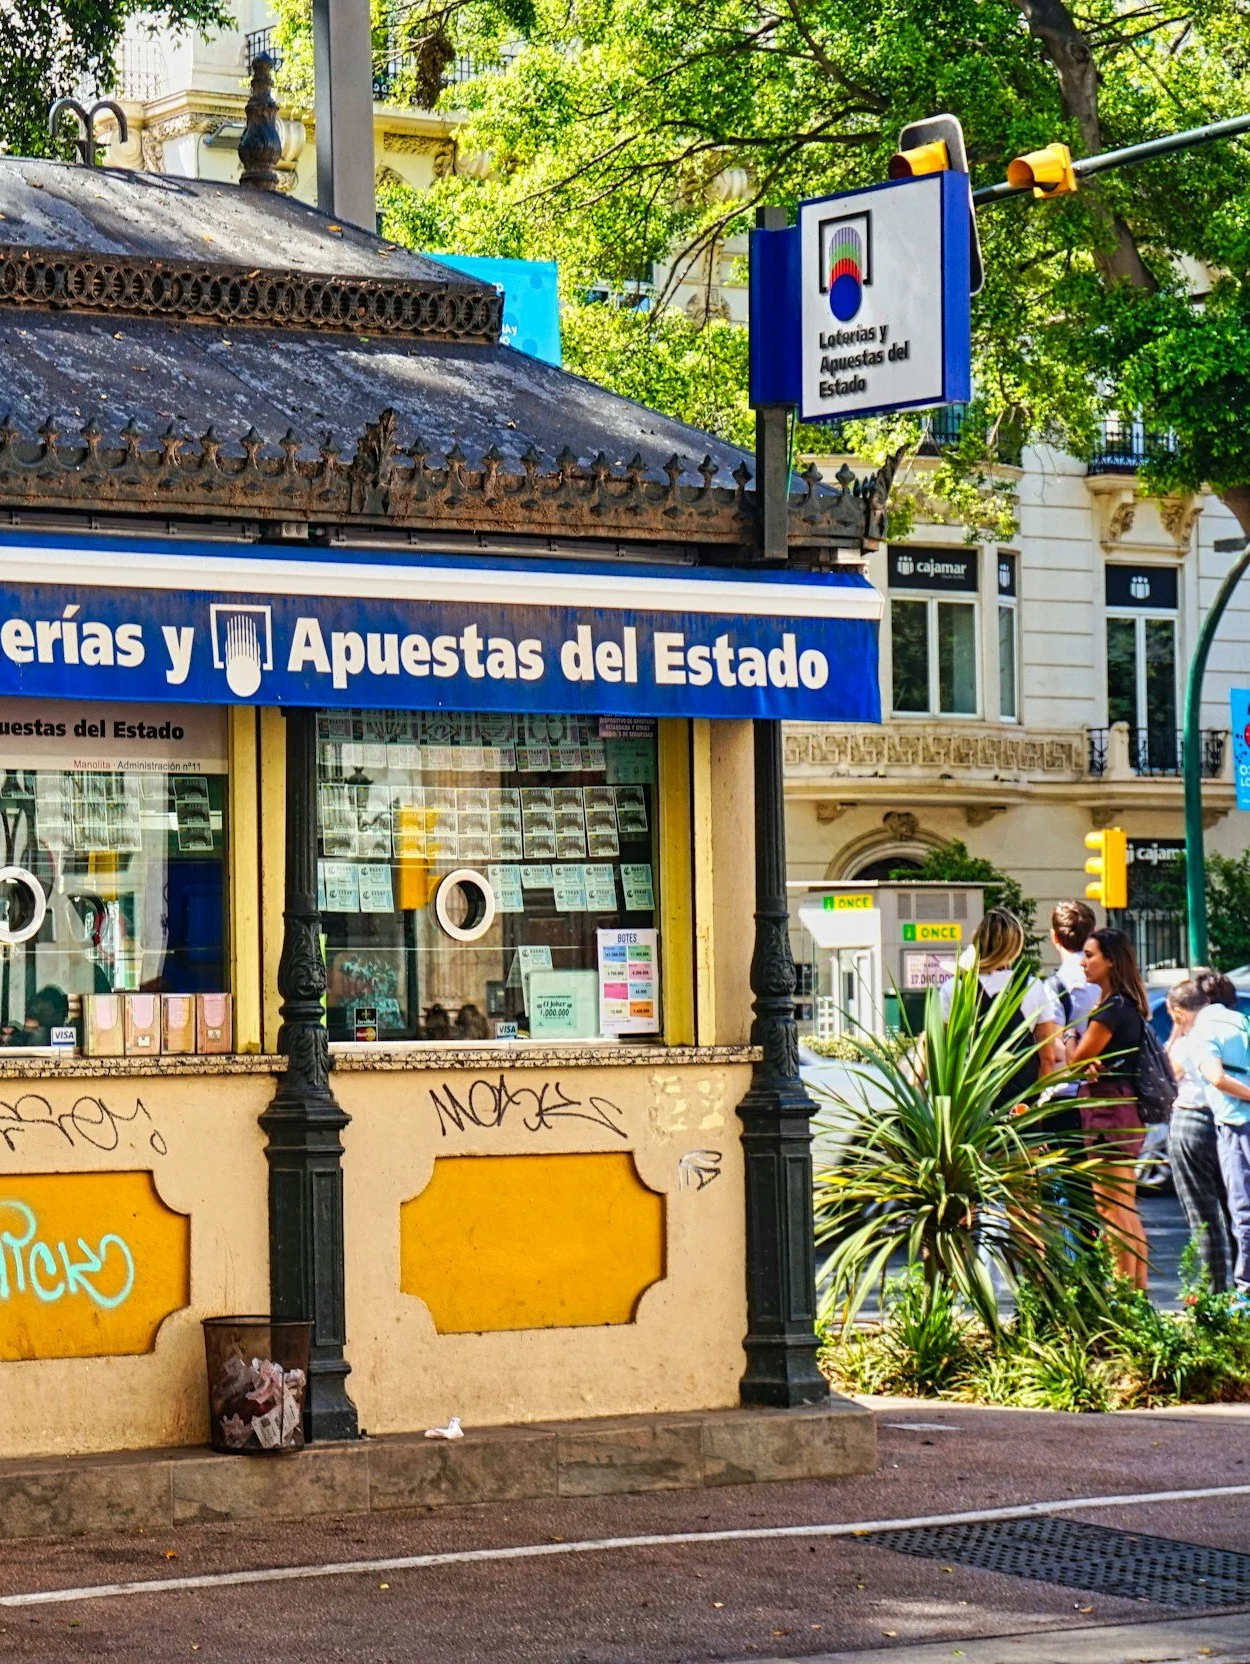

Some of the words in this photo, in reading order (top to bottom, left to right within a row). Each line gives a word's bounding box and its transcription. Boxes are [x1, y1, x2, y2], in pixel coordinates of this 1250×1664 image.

[819, 323, 877, 349] Loterías
[879, 323, 888, 344] y
[820, 347, 885, 377] Apuestas
[887, 340, 910, 362] del
[819, 375, 867, 399] Estado
[916, 558, 967, 578] cajamar
[161, 625, 195, 685] y
[287, 616, 545, 689] Apuestas
[561, 623, 638, 684] del
[654, 631, 830, 690] Estado
[73, 719, 106, 738] del
[113, 721, 184, 740] Estado
[73, 759, 111, 770] Manolita
[117, 760, 181, 771] Administración
[1136, 842, 1187, 866] cajam
[838, 896, 869, 909] ONCE
[617, 933, 638, 943] BOTES
[920, 927, 956, 938] ONCE
[55, 1031, 74, 1039] VISA
[498, 1024, 516, 1034] VISA
